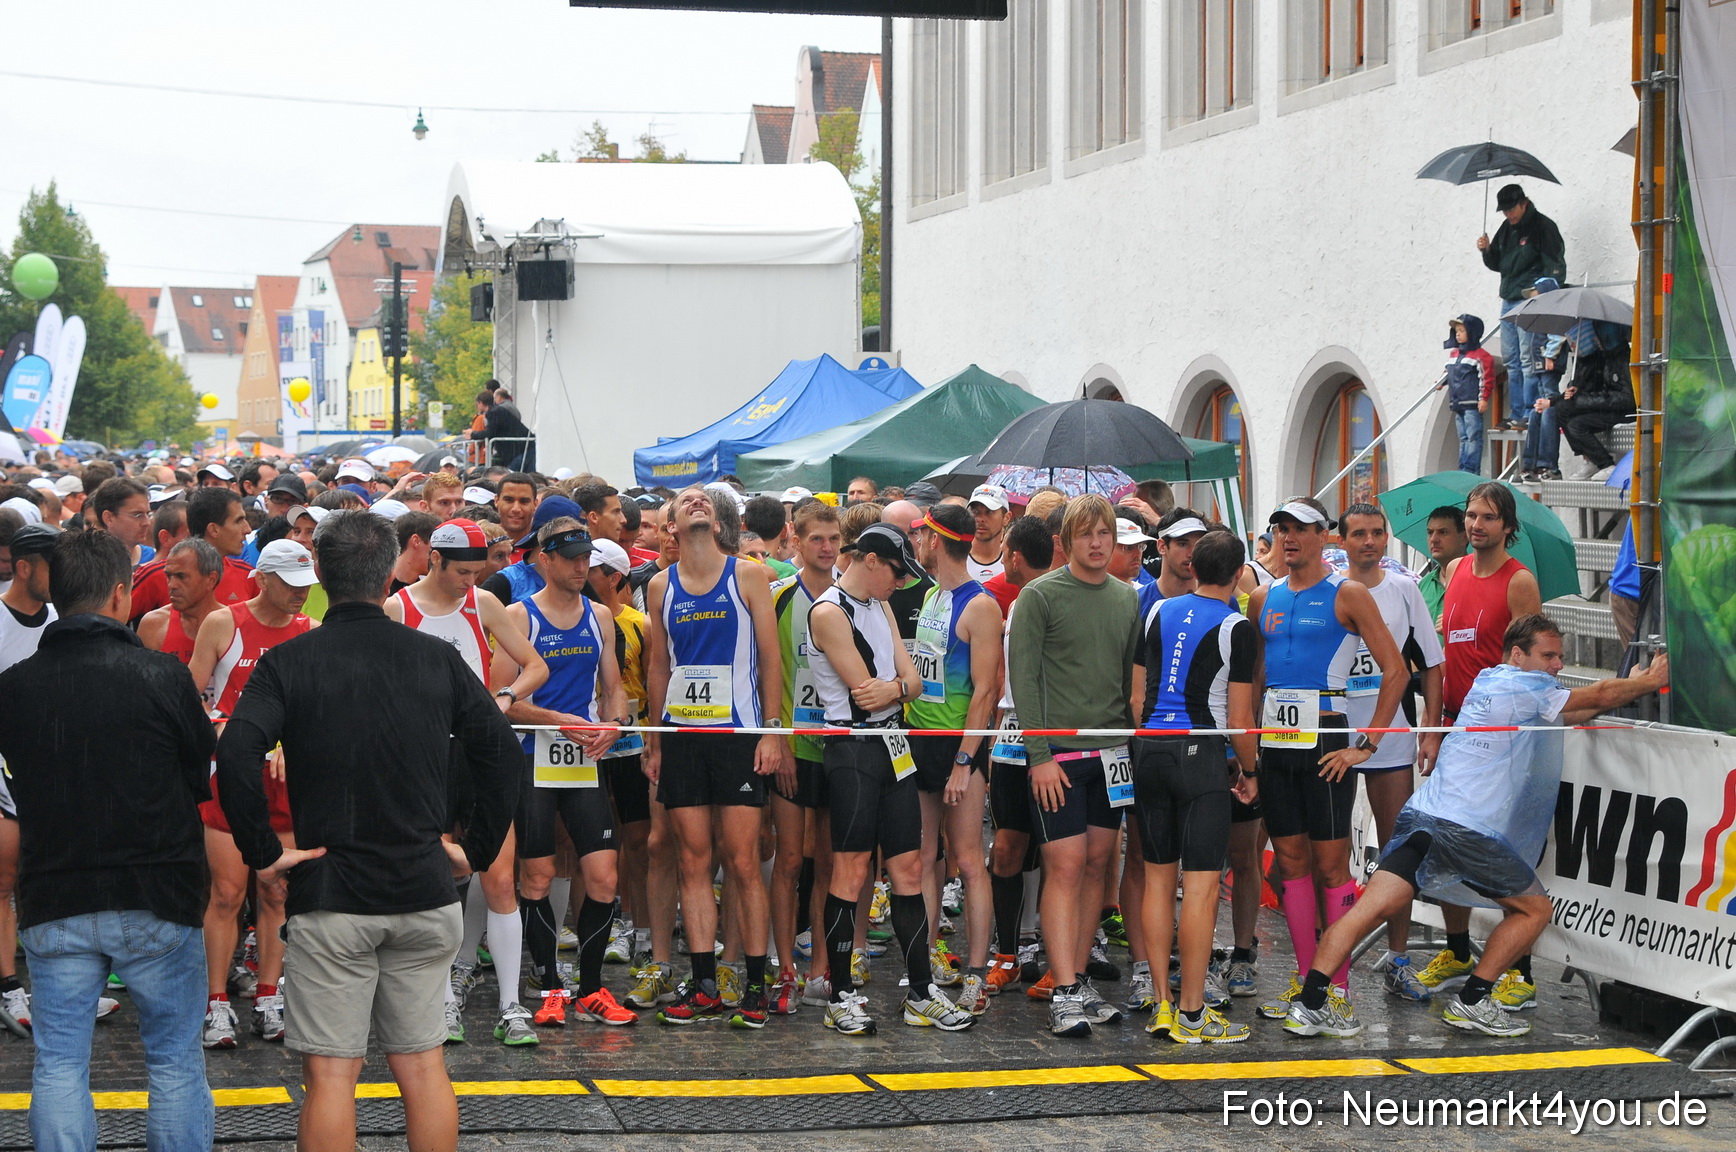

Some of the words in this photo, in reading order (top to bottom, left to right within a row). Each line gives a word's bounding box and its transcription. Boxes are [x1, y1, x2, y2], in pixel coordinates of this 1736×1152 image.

[674, 601, 696, 610] HEITEC
[676, 614, 692, 624] LAC
[693, 611, 727, 621] QUELLE
[1183, 609, 1195, 625] LA
[540, 634, 563, 643] HEITEC
[543, 650, 560, 659] LAC
[561, 646, 593, 656] QUELLE
[1167, 632, 1187, 693] CARRERA
[685, 681, 712, 704] 44
[1353, 680, 1372, 689] Rudi
[681, 707, 714, 717] Carsten
[1277, 705, 1299, 727] 40
[549, 743, 585, 765] 681
[888, 735, 906, 757] 684
[1536, 779, 1688, 904] wn
[1618, 911, 1736, 970] neumarkt
